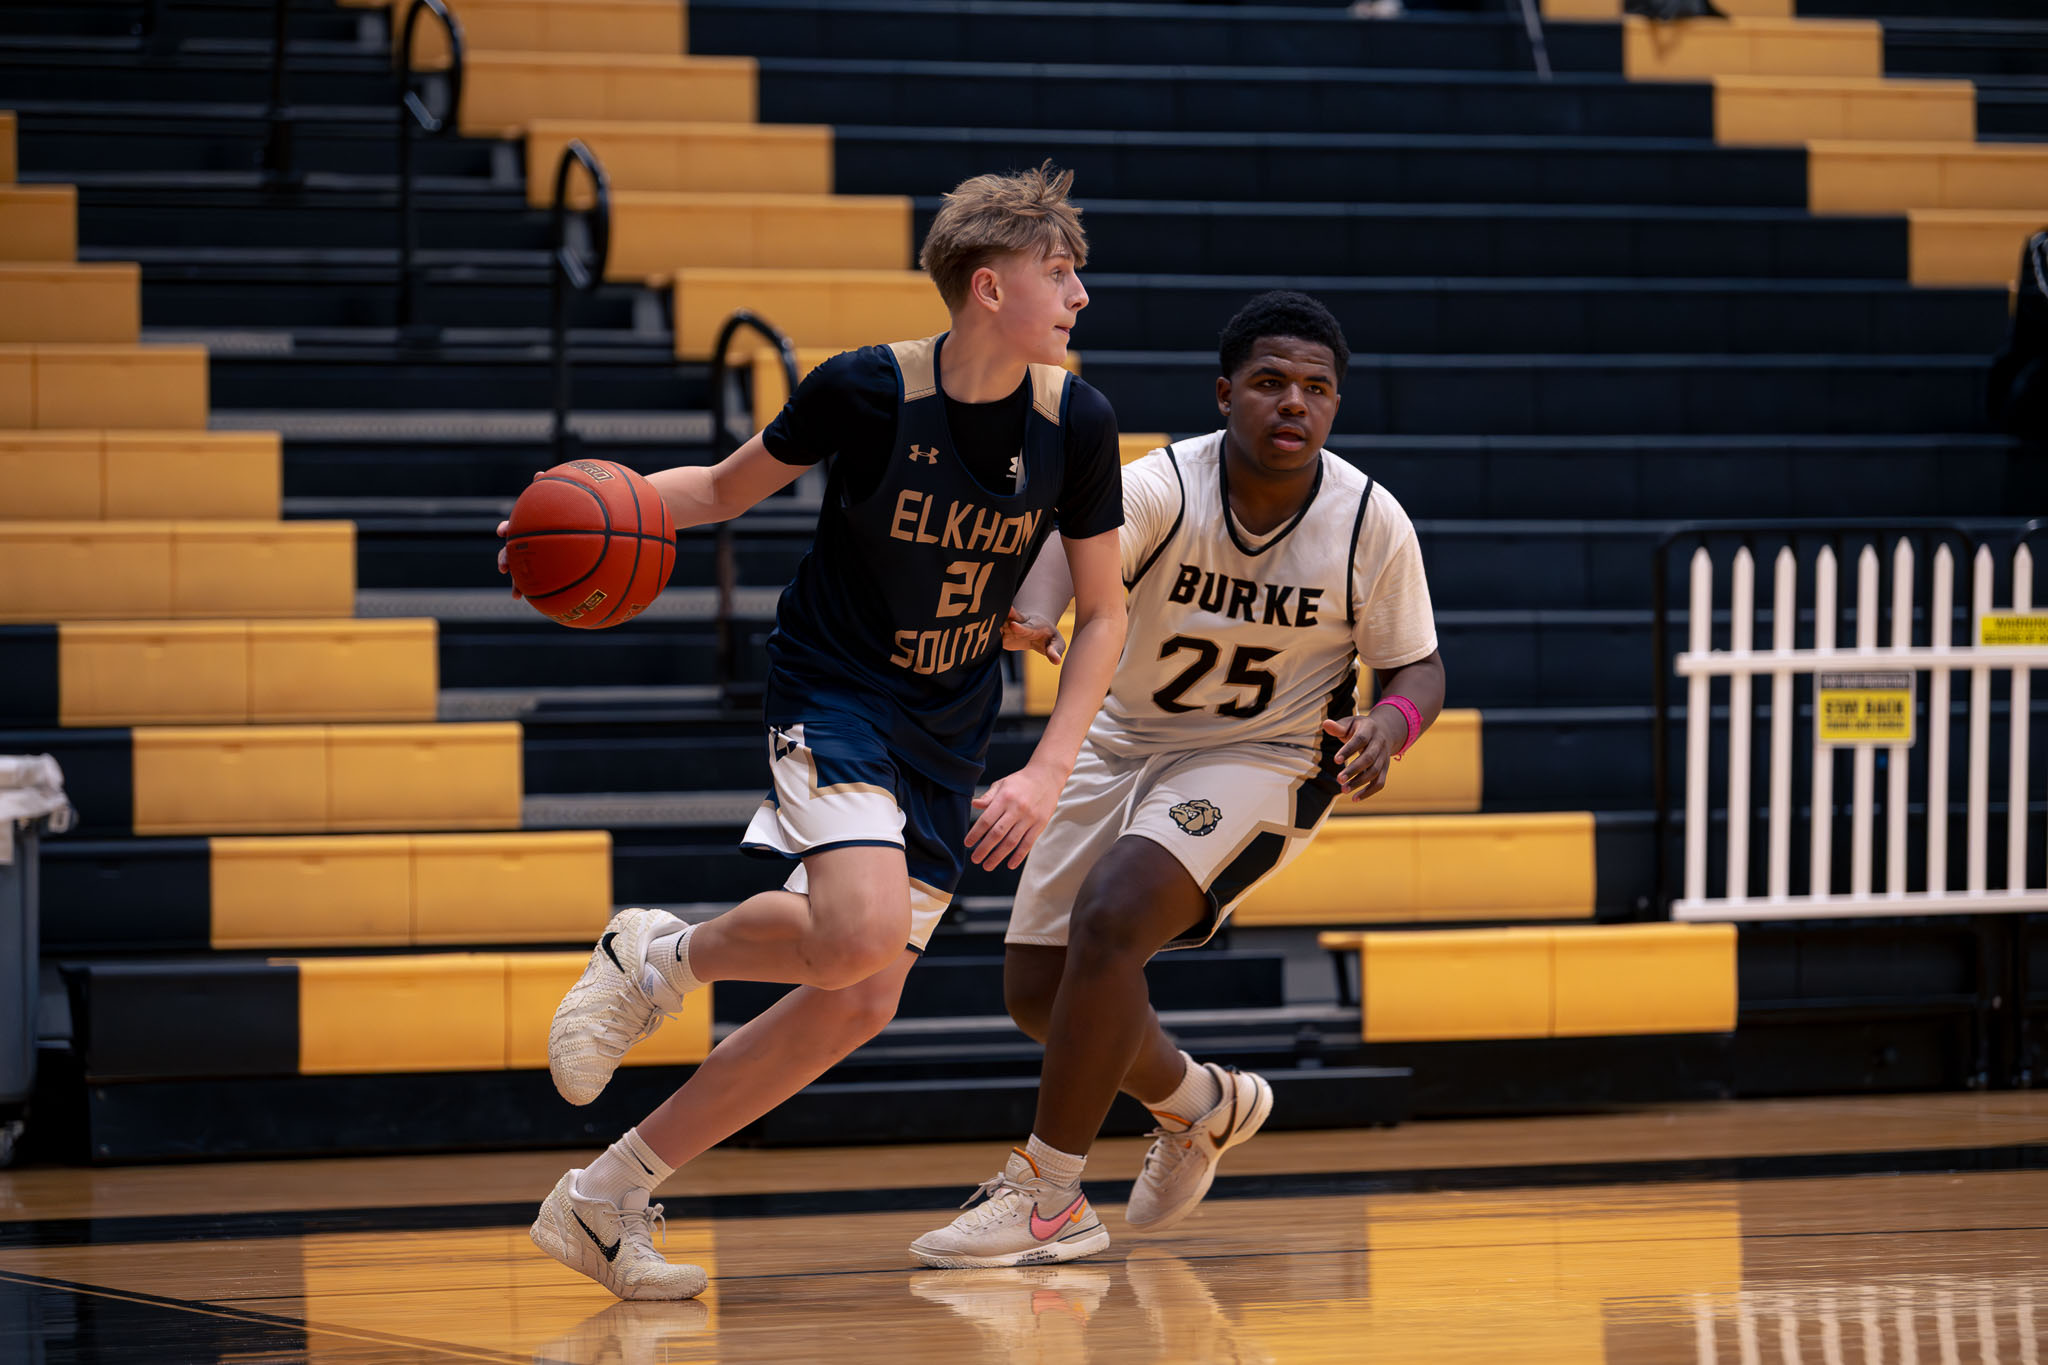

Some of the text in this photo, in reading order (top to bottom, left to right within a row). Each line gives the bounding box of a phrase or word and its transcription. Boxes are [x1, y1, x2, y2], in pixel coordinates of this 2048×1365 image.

[936, 560, 995, 618] 21
[1168, 563, 1325, 628] BURKE
[889, 613, 997, 675] SOUTH
[1152, 632, 1287, 719] 25
